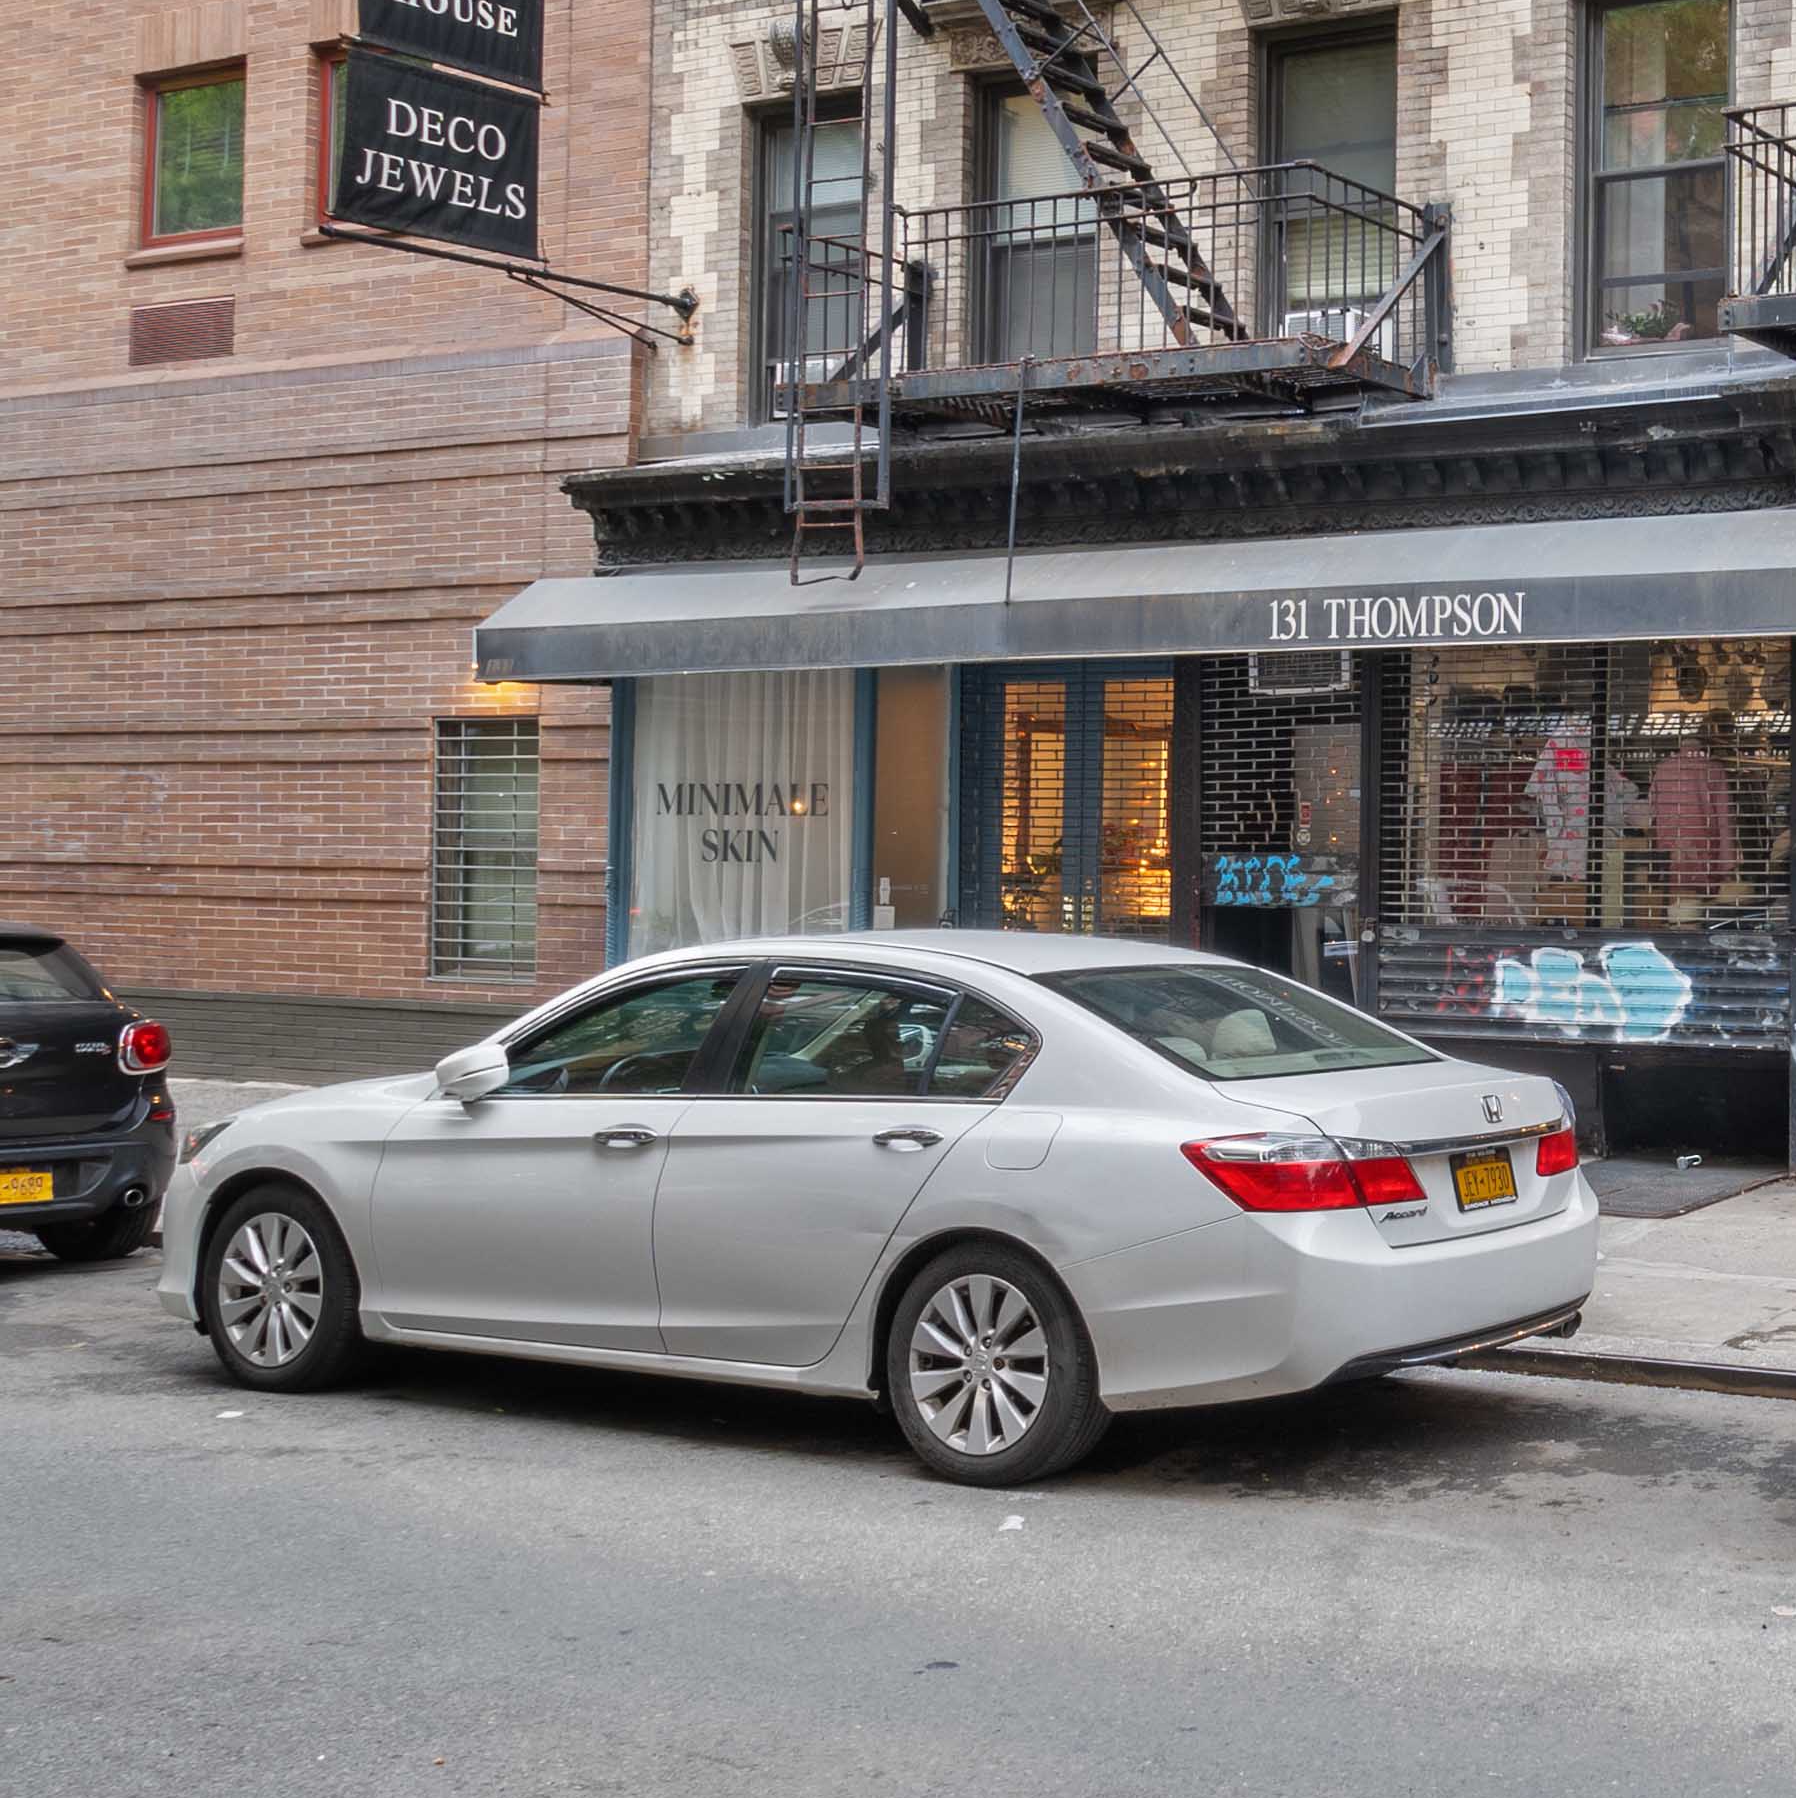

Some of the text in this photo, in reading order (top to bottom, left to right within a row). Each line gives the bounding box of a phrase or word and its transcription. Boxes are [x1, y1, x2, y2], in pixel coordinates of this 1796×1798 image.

[386, 97, 507, 162] DECO
[355, 147, 528, 220] JEWELS
[1269, 591, 1526, 641] 131 THOMPSON
[656, 780, 831, 818] MINIMALE
[700, 828, 779, 865] SKIN
